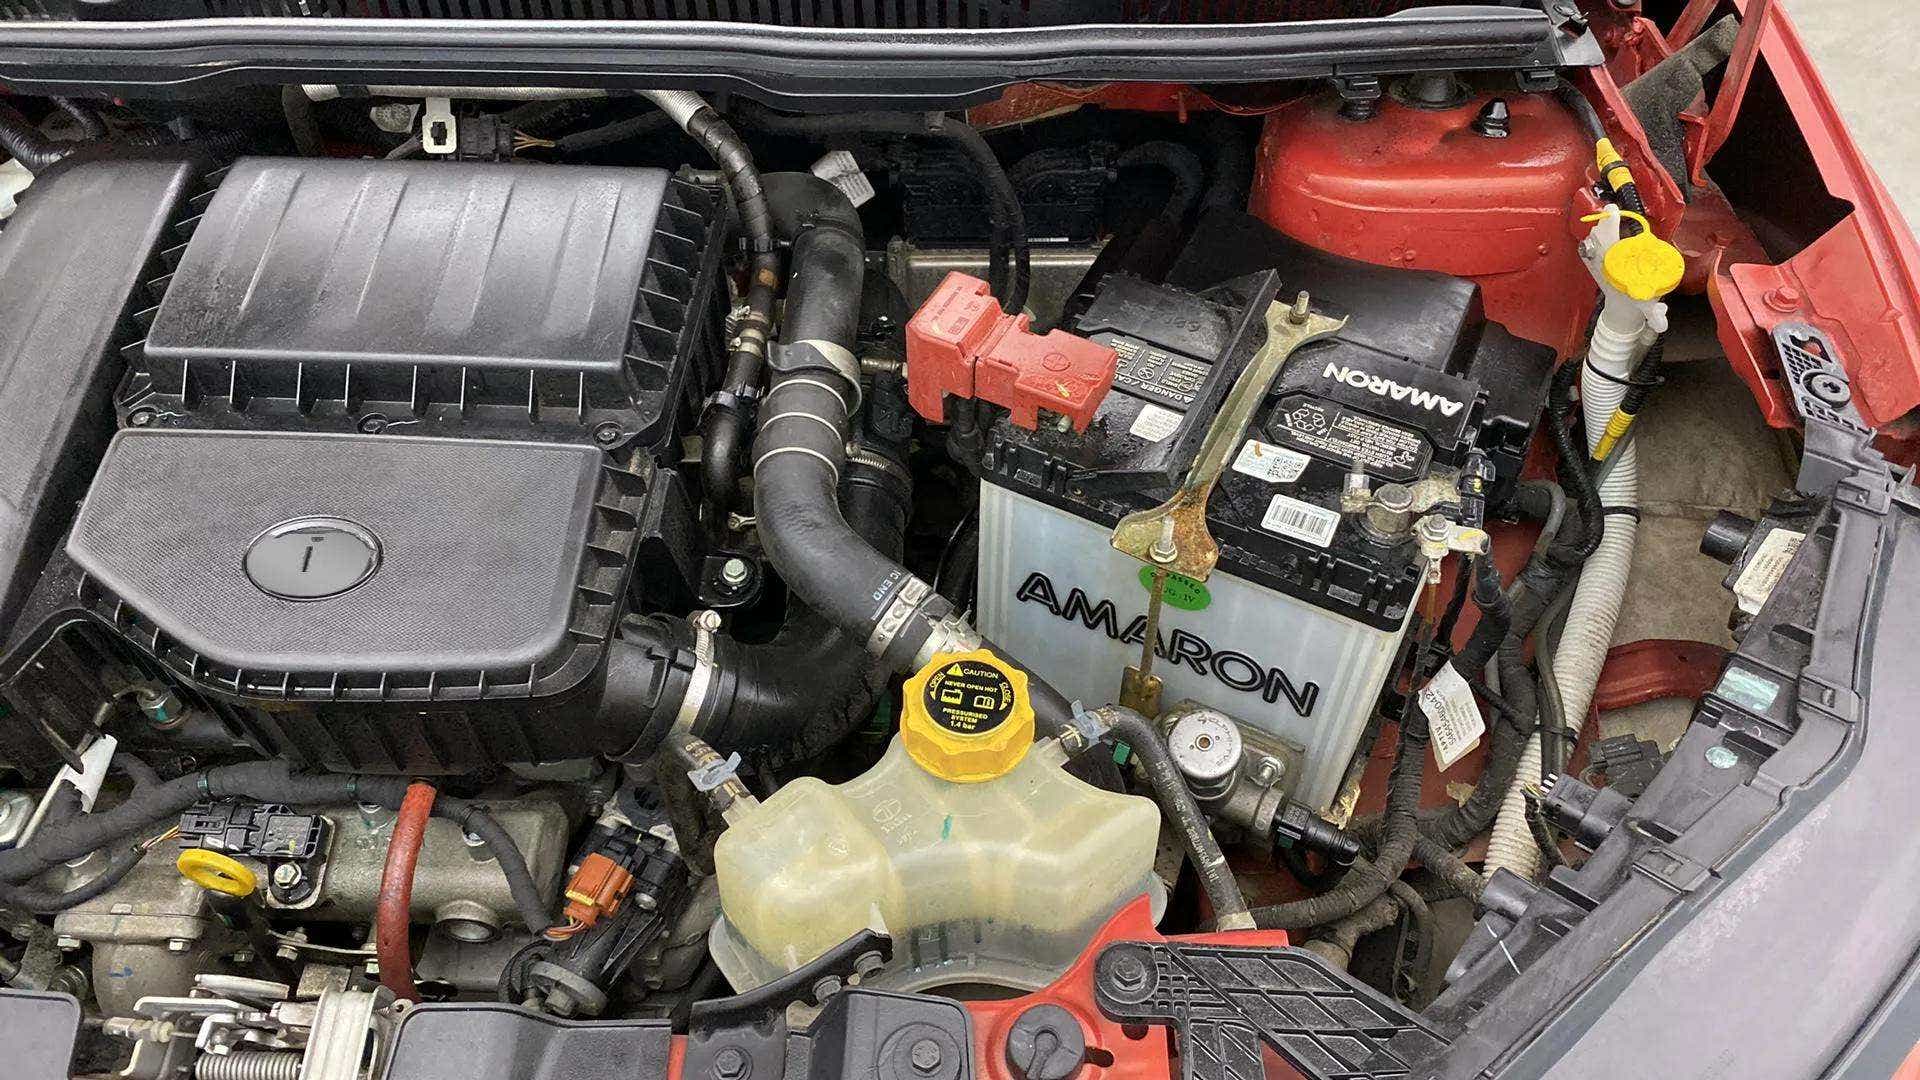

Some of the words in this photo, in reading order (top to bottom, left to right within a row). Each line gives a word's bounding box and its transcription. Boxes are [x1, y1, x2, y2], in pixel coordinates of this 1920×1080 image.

[1140, 382, 1183, 402] DANGER
[1323, 362, 1464, 417] AMARON
[871, 577, 893, 601] END
[1016, 572, 1320, 717] AMARON
[929, 672, 946, 688] OPEN
[964, 668, 999, 679] CAUTION
[945, 680, 965, 688] NEVER
[966, 683, 984, 691] OPEN
[1001, 682, 1011, 703] CLOSE
[943, 707, 988, 720] PRESSURISED
[951, 715, 977, 723] SYSTEM
[962, 722, 976, 730] bar
[1435, 726, 1449, 751] APTIV
